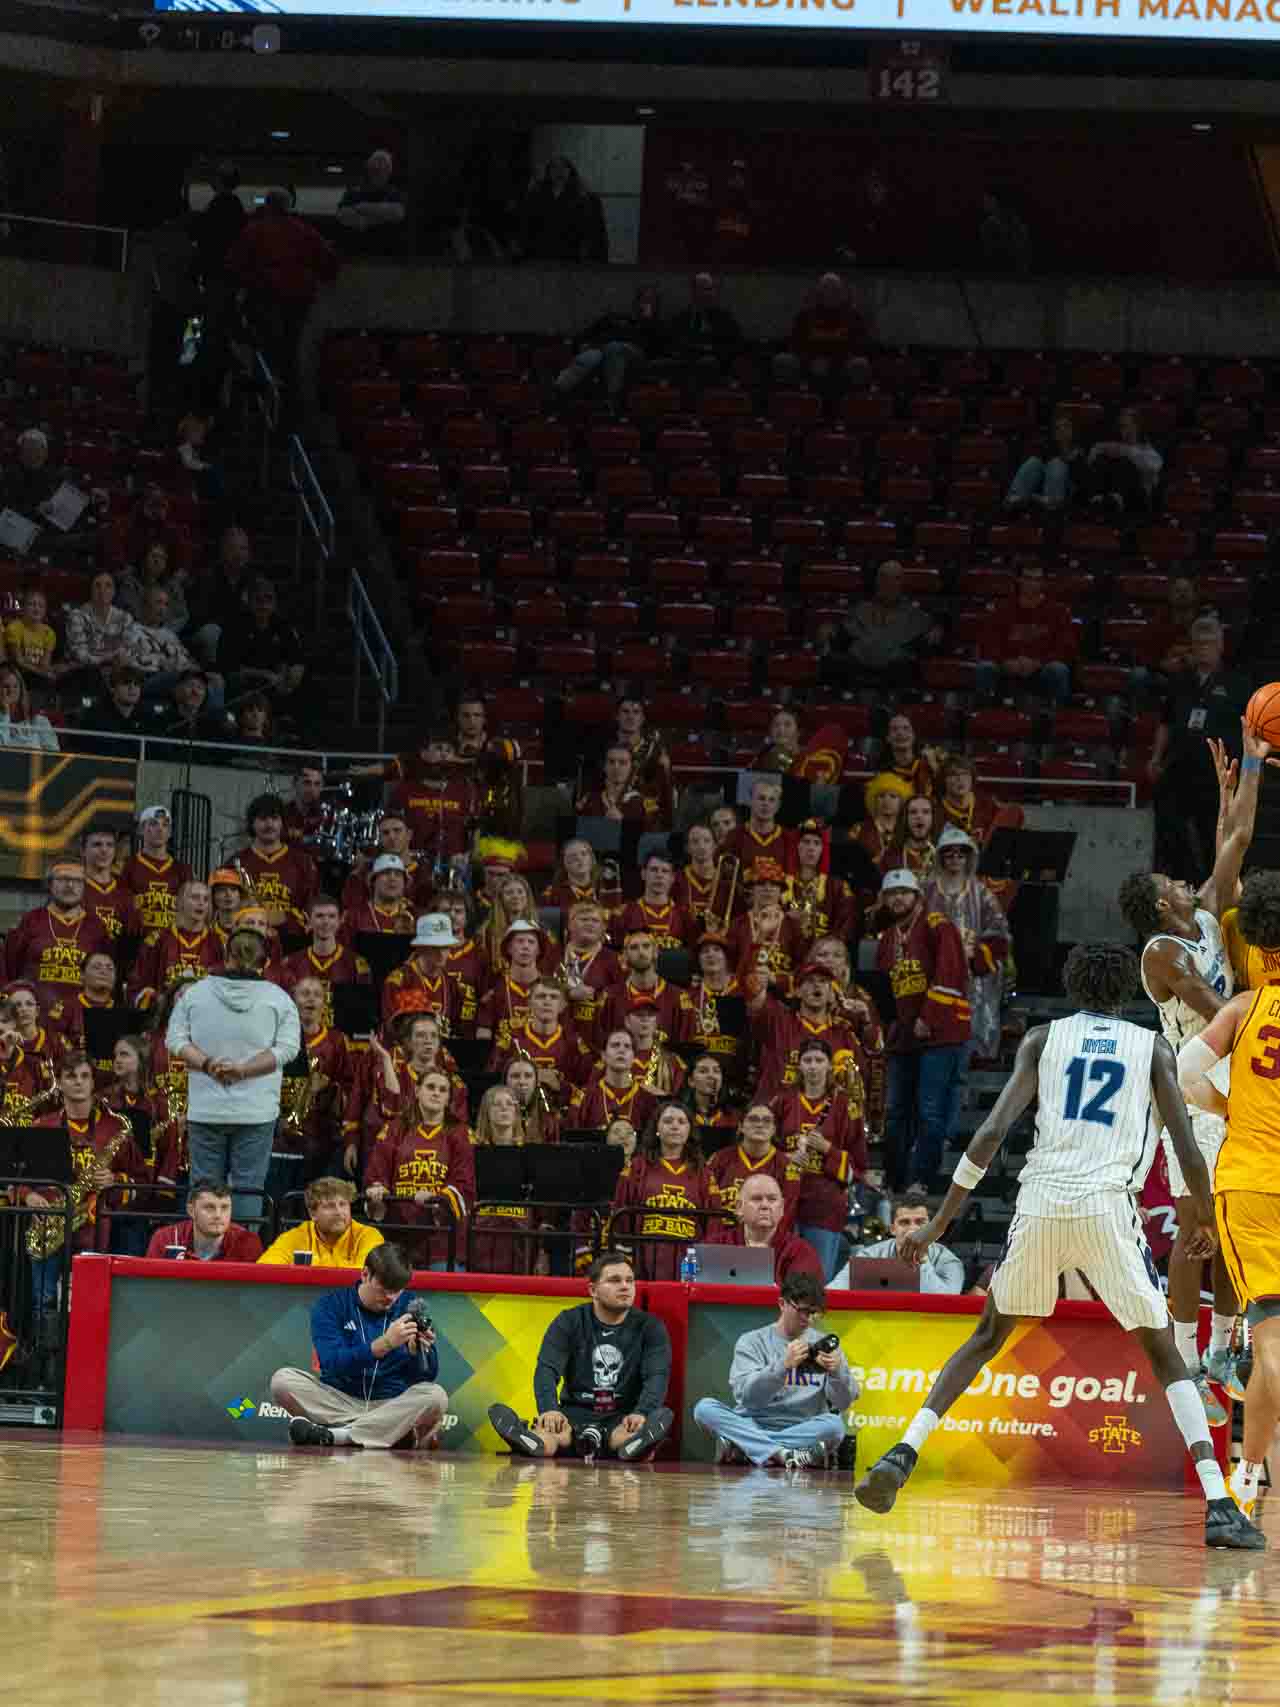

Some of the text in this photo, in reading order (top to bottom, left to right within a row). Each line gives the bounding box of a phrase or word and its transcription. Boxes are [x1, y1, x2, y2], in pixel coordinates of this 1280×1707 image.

[877, 69, 939, 99] 142
[1062, 1056, 1126, 1127] 12
[399, 1161, 449, 1179] STATE
[1050, 1371, 1147, 1408] goal.
[848, 1411, 906, 1429] lower
[989, 1418, 1059, 1438] future.
[1088, 1425, 1143, 1448] STATE
